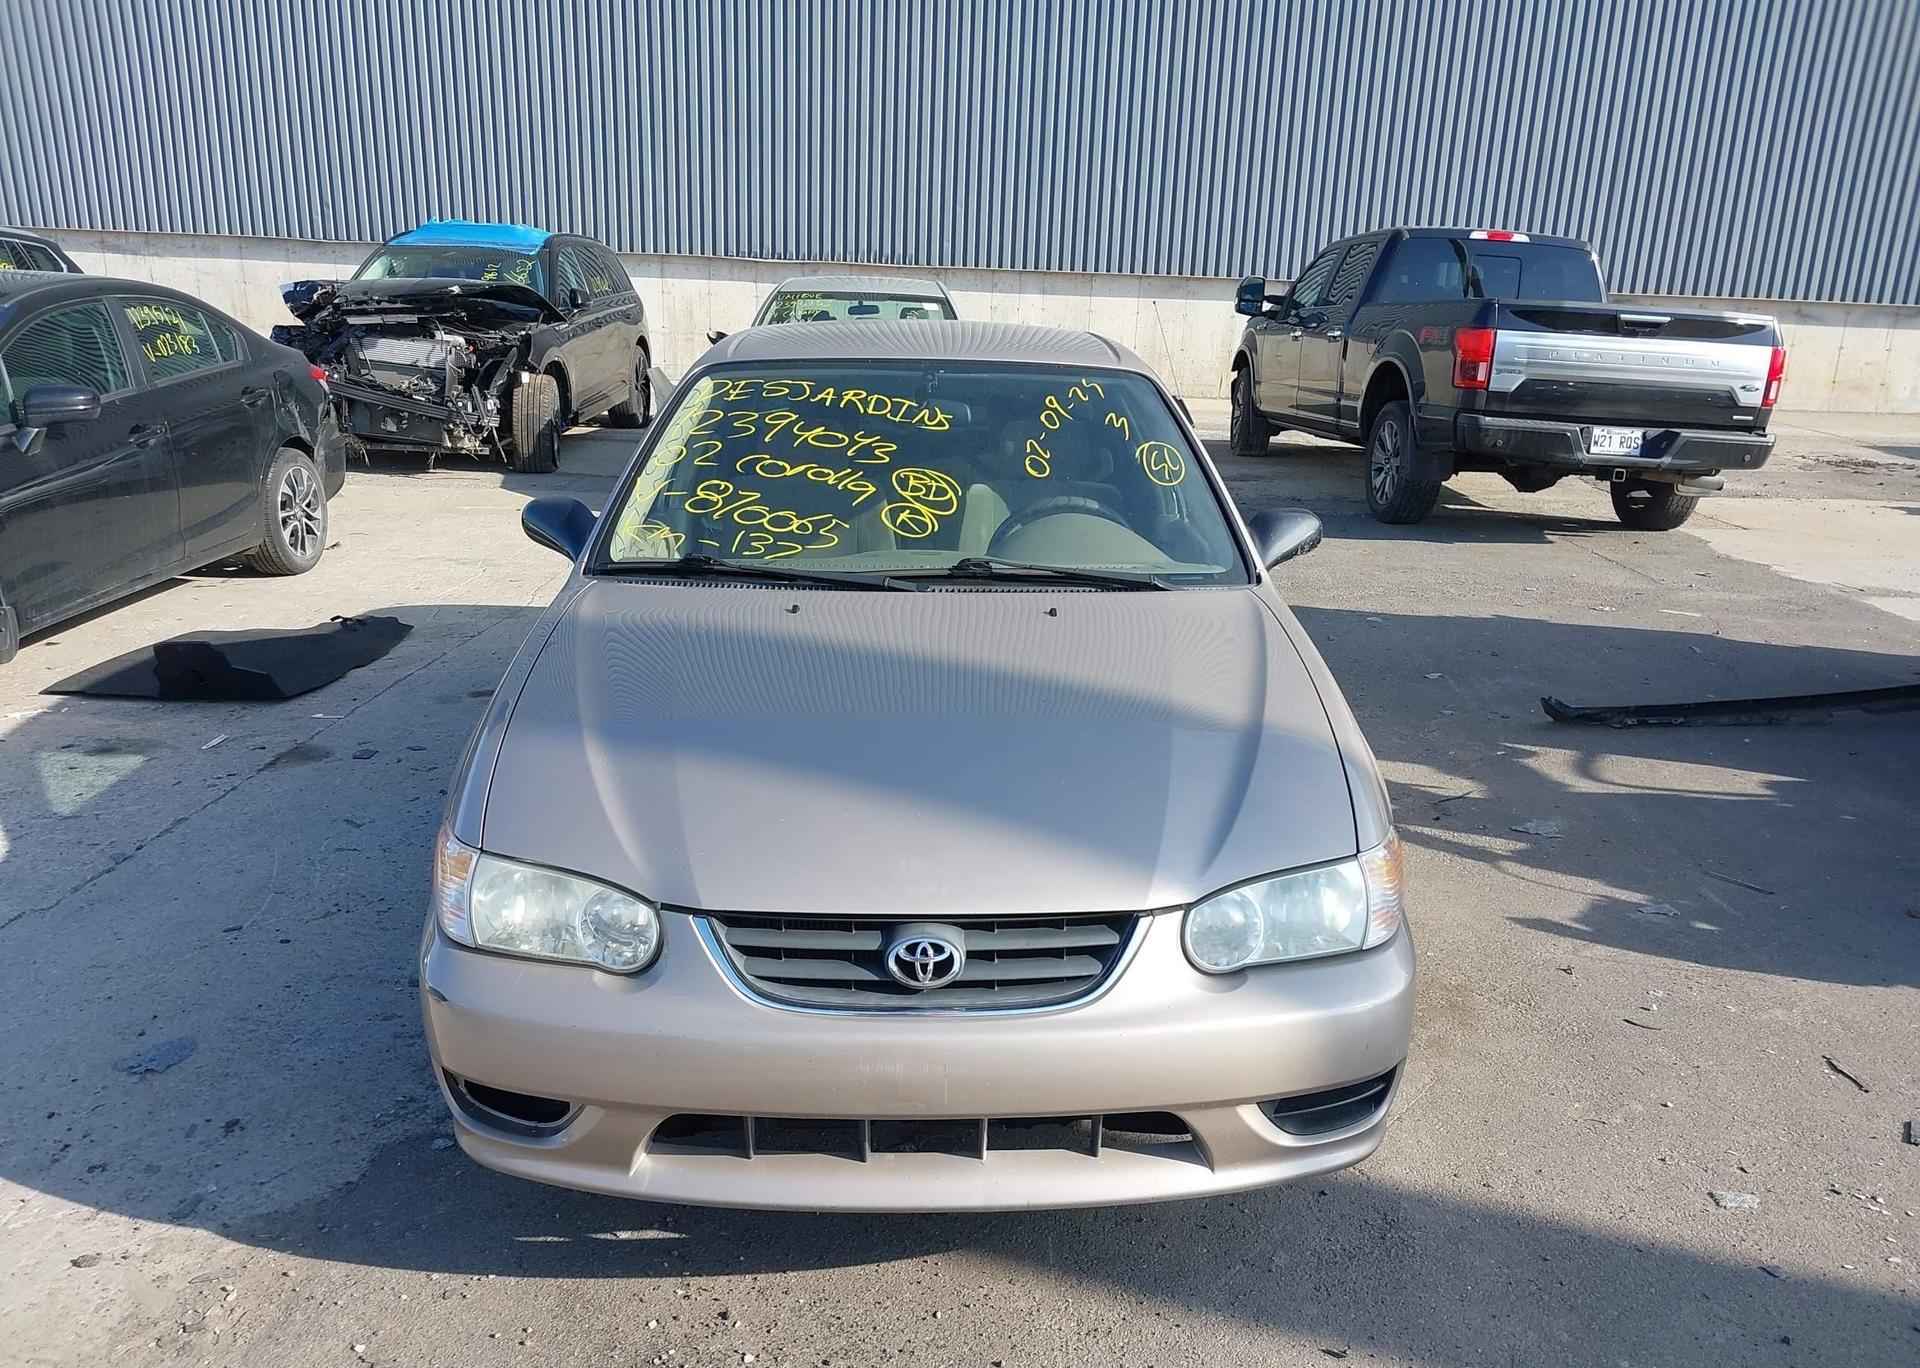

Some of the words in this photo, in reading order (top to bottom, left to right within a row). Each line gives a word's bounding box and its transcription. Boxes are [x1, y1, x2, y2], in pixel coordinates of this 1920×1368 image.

[1549, 350, 1720, 368] PLATINUM
[700, 378, 953, 430] DESJARDINS
[1593, 434, 1613, 449] W21
